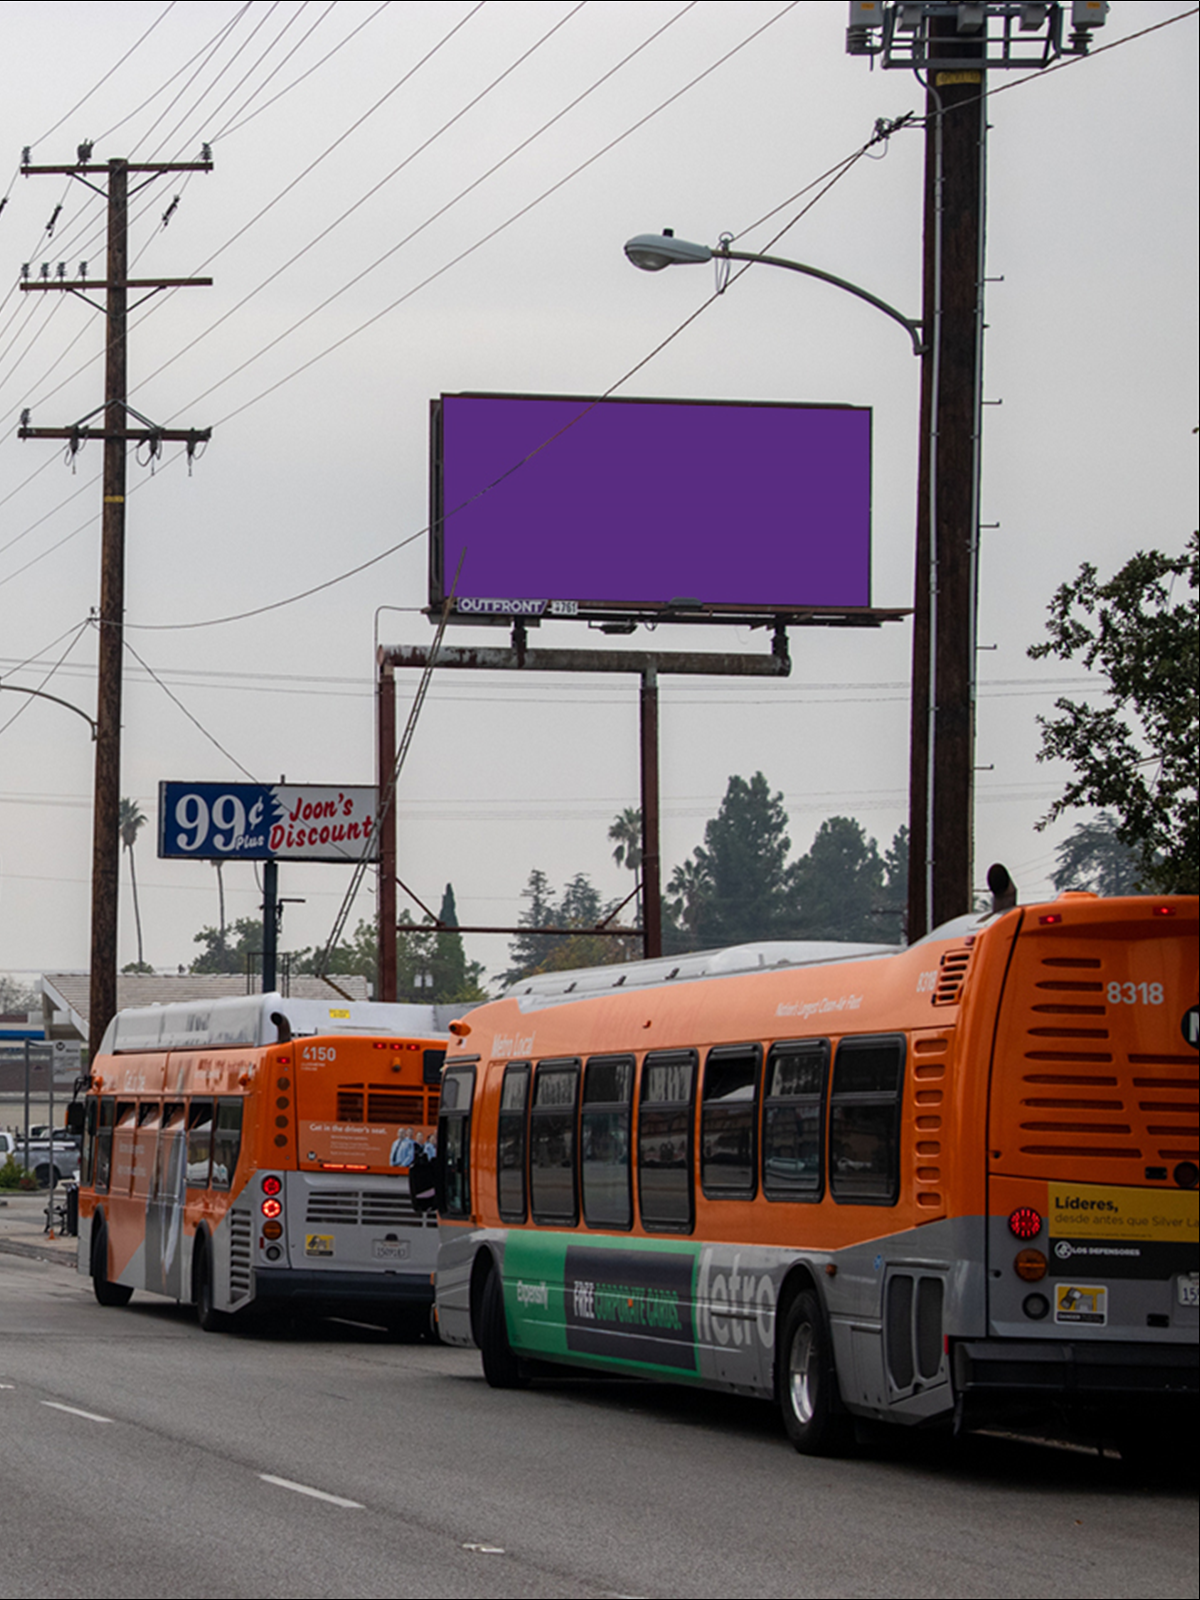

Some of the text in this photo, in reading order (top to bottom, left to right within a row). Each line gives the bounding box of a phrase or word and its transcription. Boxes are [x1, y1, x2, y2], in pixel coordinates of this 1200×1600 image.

[461, 599, 542, 613] OUTFRONT
[290, 793, 353, 822] Joon's
[270, 816, 372, 850] Discount
[235, 835, 265, 850] Plus
[1107, 981, 1164, 1005] 8318
[302, 1046, 336, 1062] 4150
[491, 1033, 513, 1058] Metro
[324, 1124, 331, 1132] in
[332, 1125, 343, 1133] the
[345, 1126, 370, 1134] driver's
[1055, 1196, 1118, 1213] Líderes,
[1055, 1213, 1089, 1225] desde
[1092, 1215, 1124, 1226] antes
[1126, 1218, 1148, 1228] que
[1152, 1215, 1183, 1227] Silver
[1072, 1247, 1088, 1255] LOS
[517, 1280, 548, 1310] Expensify
[574, 1280, 595, 1319] FREE
[594, 1283, 646, 1326] CORPORATE
